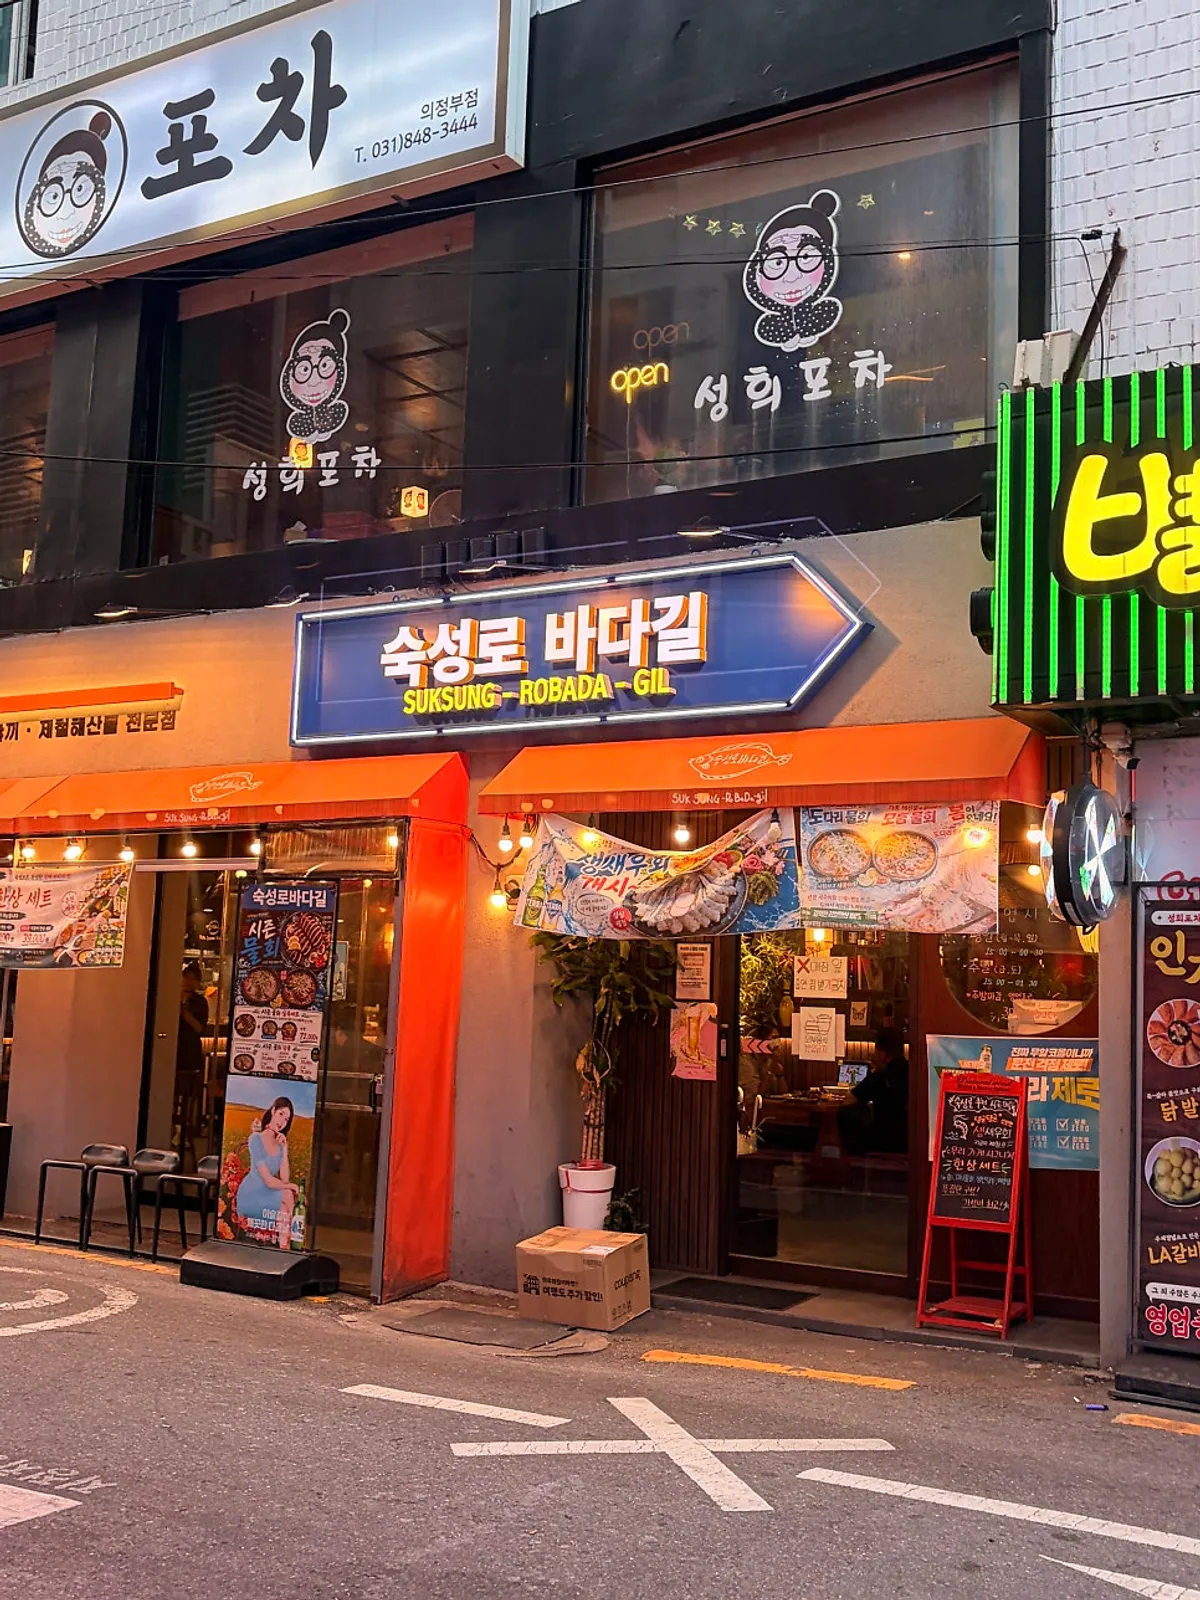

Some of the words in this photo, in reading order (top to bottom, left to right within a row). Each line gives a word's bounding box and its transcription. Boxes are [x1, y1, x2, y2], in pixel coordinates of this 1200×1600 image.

[140, 29, 347, 200] 포차
[420, 88, 479, 121] 의정부점
[372, 115, 478, 160] 031)848-3444
[610, 361, 670, 404] open
[381, 616, 529, 688] 숙성로
[545, 591, 708, 673] 바다길
[403, 682, 500, 715] SUKSUNG
[519, 673, 614, 706] ROBADA
[633, 667, 676, 697] GIL
[25, 887, 53, 911] 세트
[252, 888, 327, 909] 숙성로바다길
[248, 919, 276, 940] 시즌
[240, 936, 281, 966] 물회
